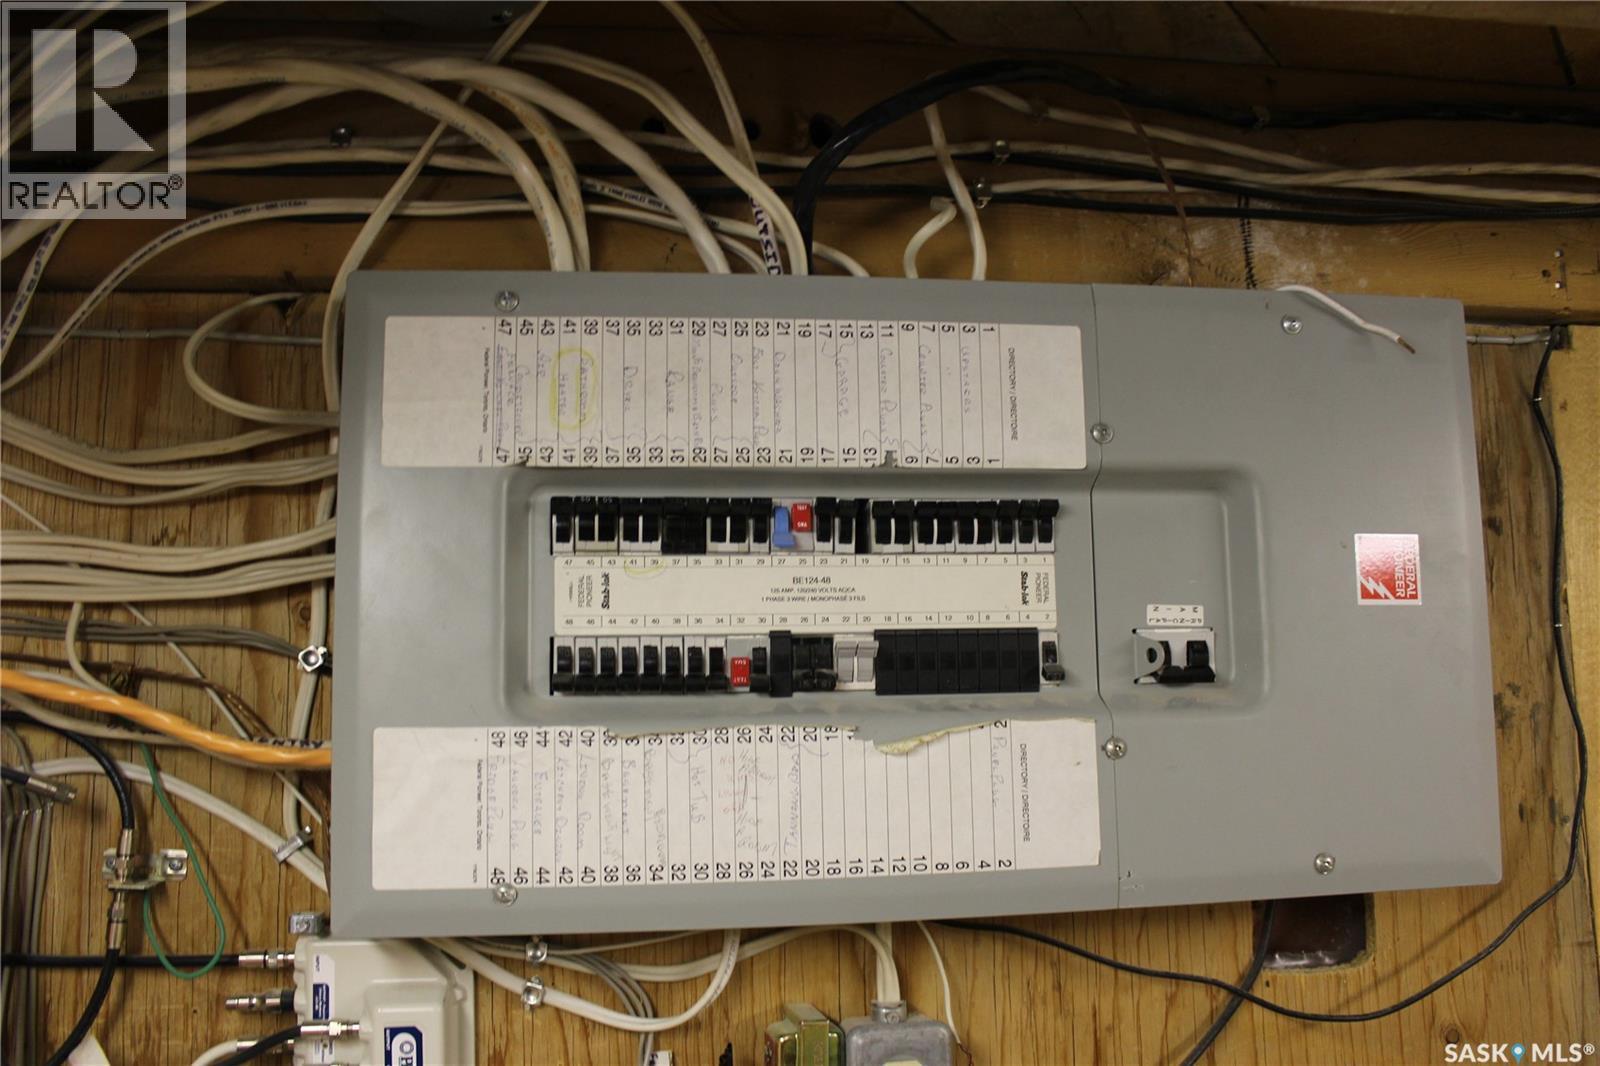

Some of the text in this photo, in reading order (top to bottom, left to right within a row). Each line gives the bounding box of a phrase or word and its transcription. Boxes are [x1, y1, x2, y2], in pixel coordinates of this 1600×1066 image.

[498, 319, 512, 335] 47
[519, 320, 533, 335] 45
[540, 320, 554, 335] 43
[564, 320, 576, 334] 41
[584, 320, 598, 336] 39
[606, 320, 620, 335] 37
[627, 320, 641, 336] 35
[648, 320, 662, 336] 33
[670, 320, 683, 334] 31
[692, 321, 705, 336] 29
[712, 321, 726, 336] 27
[734, 321, 748, 337] 25
[756, 322, 769, 337] 23
[777, 322, 790, 335] 21
[798, 322, 811, 338] 19
[819, 322, 832, 338] 17
[840, 323, 853, 338] 15
[860, 324, 873, 338] 13
[881, 324, 894, 336] 11
[963, 325, 976, 333] 3
[1007, 347, 1018, 440] DIRECTORY DIRECTOIRE
[497, 448, 510, 463] 47
[518, 448, 533, 464] 45
[540, 448, 553, 464] 43
[562, 450, 576, 464] 41
[584, 448, 598, 464] 39
[606, 448, 620, 464] 37
[627, 448, 641, 463] 35
[648, 448, 662, 463] 33
[671, 450, 684, 464] 31
[692, 448, 706, 464] 29
[714, 448, 727, 464] 27
[736, 448, 749, 464] 25
[757, 448, 770, 463] 23
[779, 450, 792, 463] 21
[800, 448, 813, 463] 19
[822, 448, 834, 463] 17
[843, 448, 856, 463] 15
[864, 448, 877, 464] 13
[491, 732, 506, 747] 48
[514, 732, 528, 747] 46
[536, 731, 550, 746] 44
[558, 731, 572, 747] 42
[581, 731, 595, 747] 40
[715, 727, 728, 743] 28
[738, 726, 751, 742] 26
[759, 726, 772, 743] 24
[781, 726, 794, 743] 22
[804, 726, 817, 742] 20
[825, 724, 838, 740] 18
[1020, 744, 1030, 842] DIRECTORY DIRECTOIRE
[694, 864, 708, 880] 30
[716, 863, 730, 880] 28
[739, 862, 753, 878] 26
[761, 862, 774, 878] 24
[784, 861, 798, 877] 22
[806, 860, 820, 877] 20
[827, 859, 841, 875] 18
[849, 858, 862, 875] 16
[870, 858, 883, 874] 14
[893, 857, 906, 873] 12
[914, 856, 927, 872] 10
[978, 862, 991, 870] 4
[998, 860, 1012, 868] 2
[491, 868, 505, 884] 48
[514, 868, 528, 884] 46
[536, 867, 550, 885] 44
[558, 867, 574, 884] 42
[581, 866, 597, 884] 40
[604, 866, 618, 882] 38
[626, 865, 640, 881] 36
[649, 865, 664, 881] 34
[671, 864, 686, 881] 32
